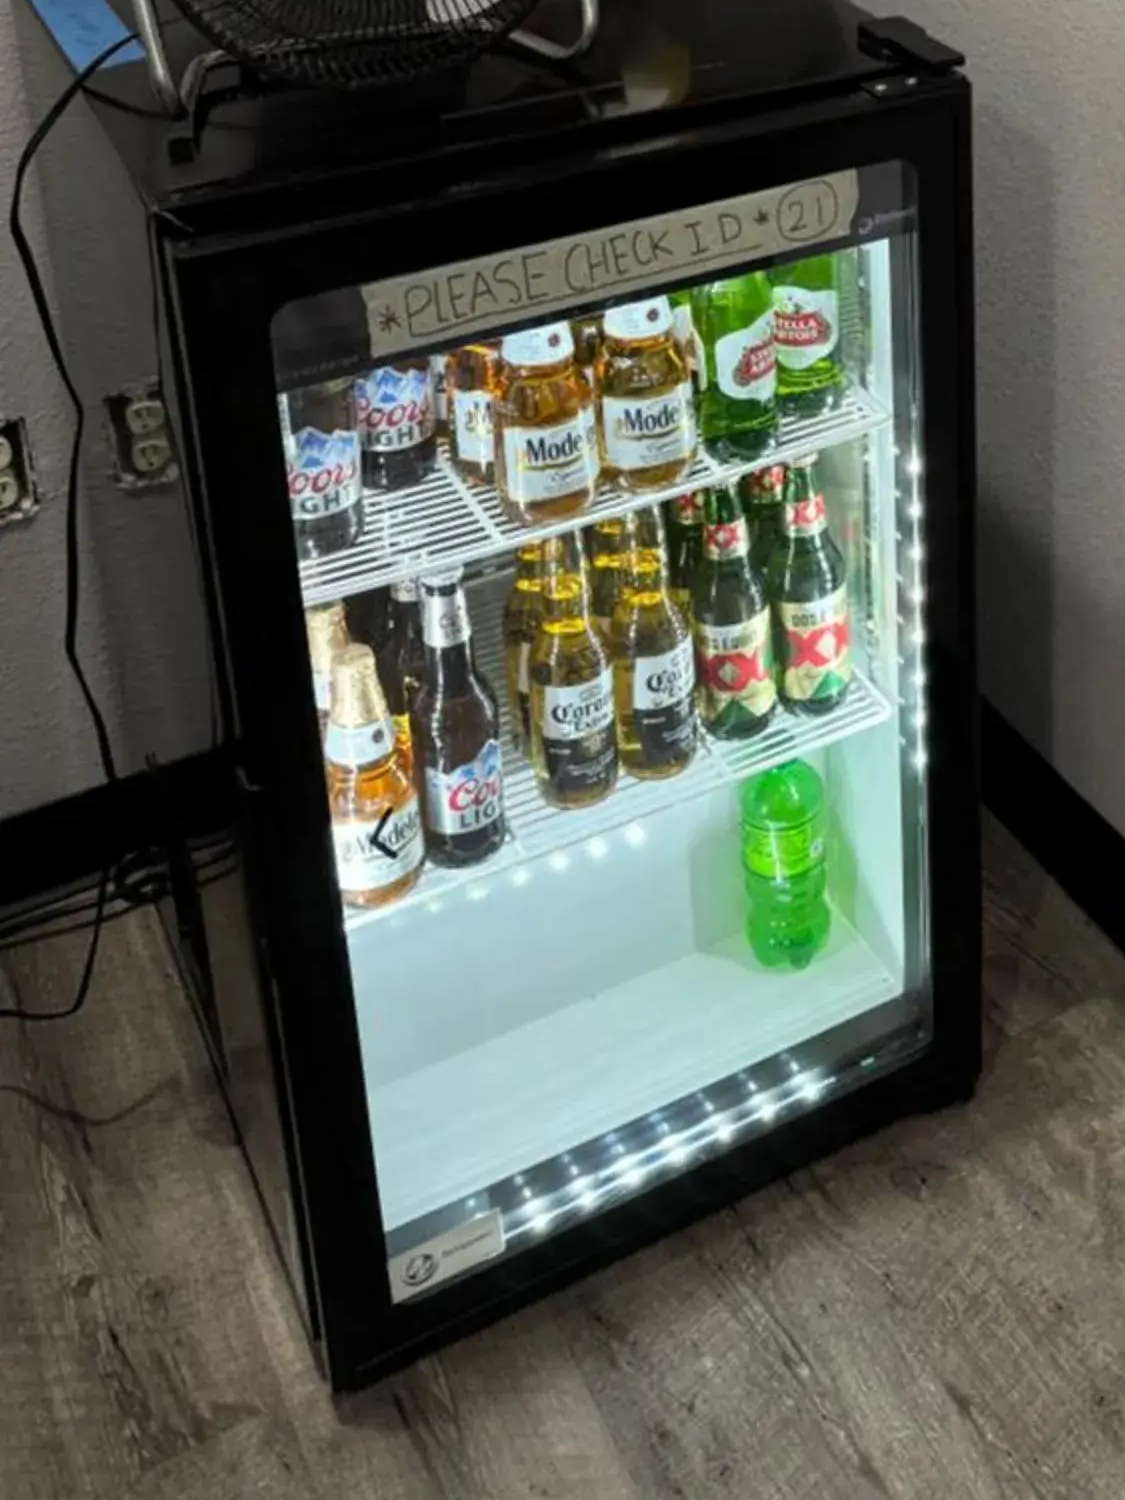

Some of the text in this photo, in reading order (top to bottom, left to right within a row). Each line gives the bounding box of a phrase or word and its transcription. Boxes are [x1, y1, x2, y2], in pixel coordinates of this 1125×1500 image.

[404, 252, 551, 328] PLEASE
[565, 229, 672, 292] CHECK
[624, 405, 681, 433] Mode
[526, 430, 582, 464] Mode
